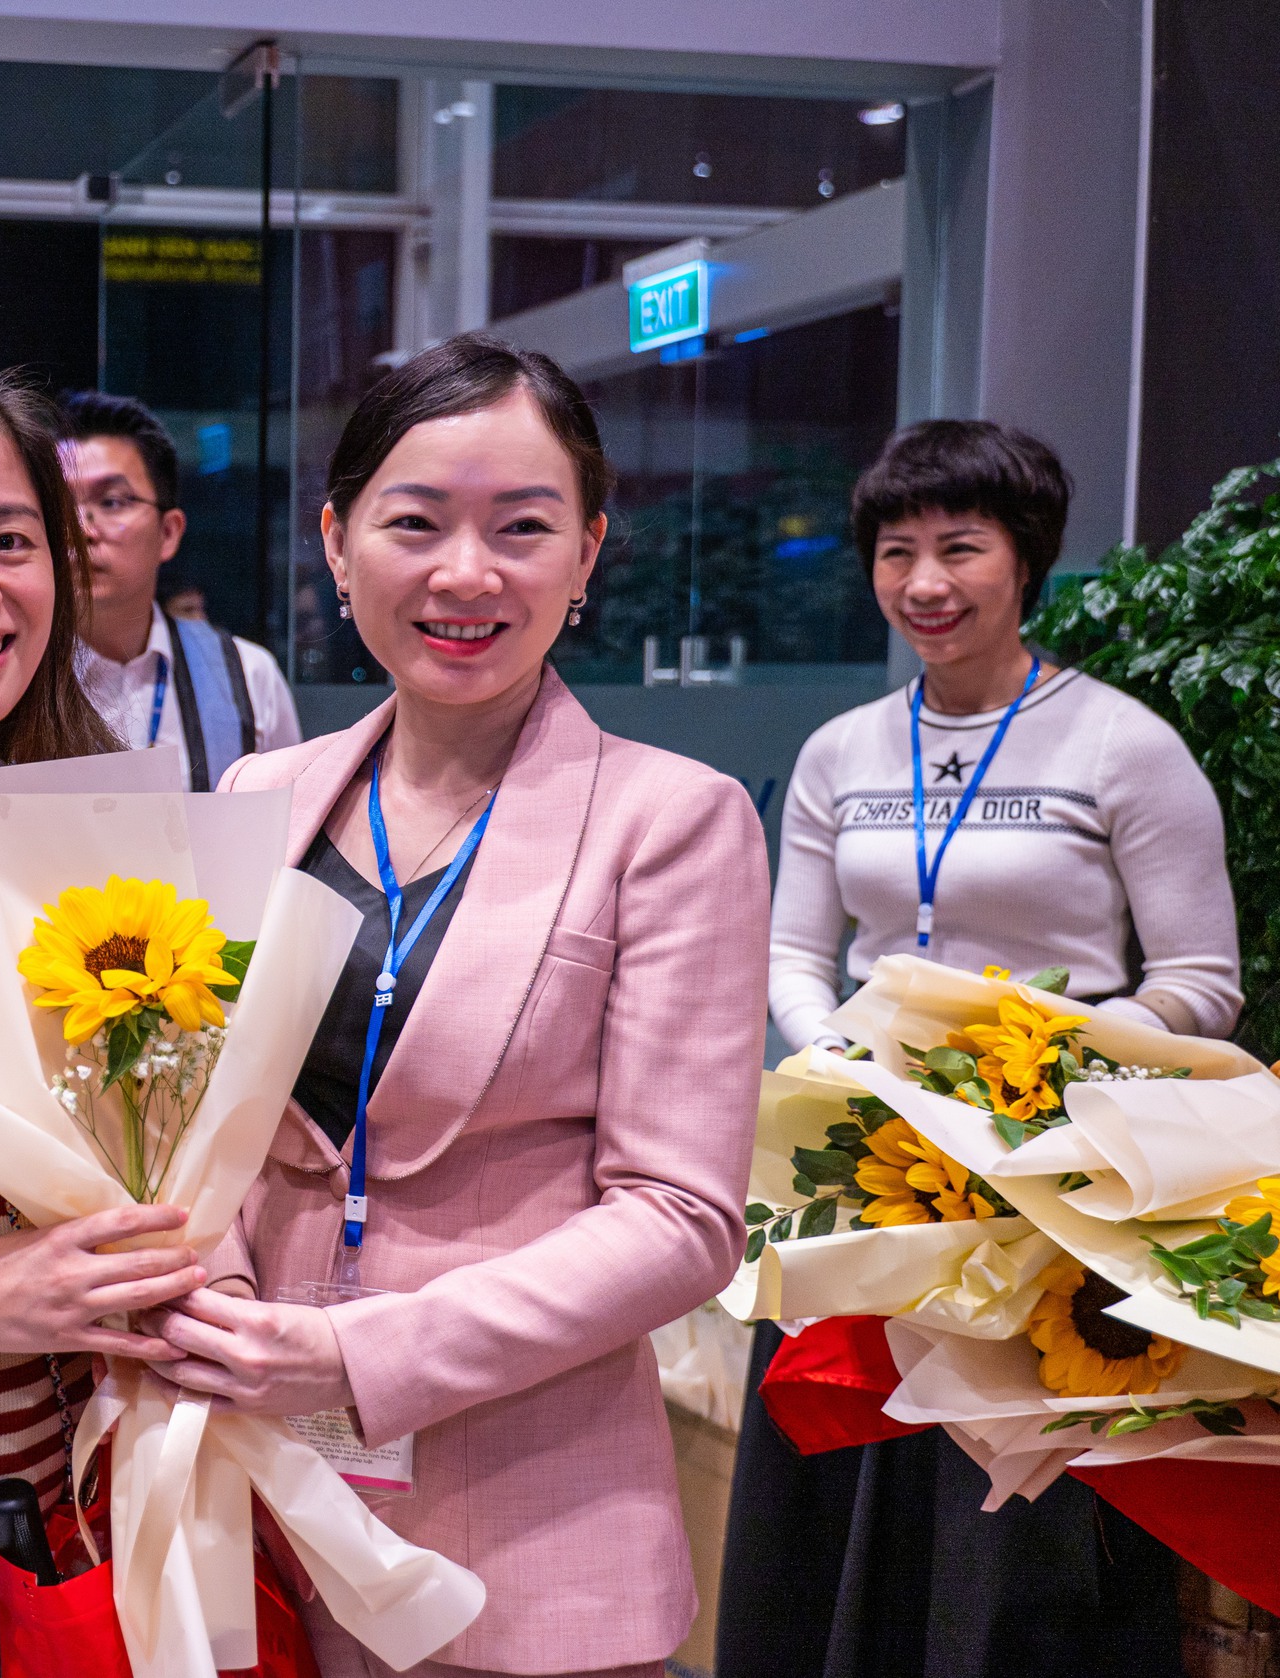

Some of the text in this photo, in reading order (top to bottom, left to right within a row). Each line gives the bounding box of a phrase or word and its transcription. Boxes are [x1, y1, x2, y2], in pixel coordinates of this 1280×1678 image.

[641, 279, 689, 334] EXIT
[853, 799, 1041, 821] CHRISIA DIOR
